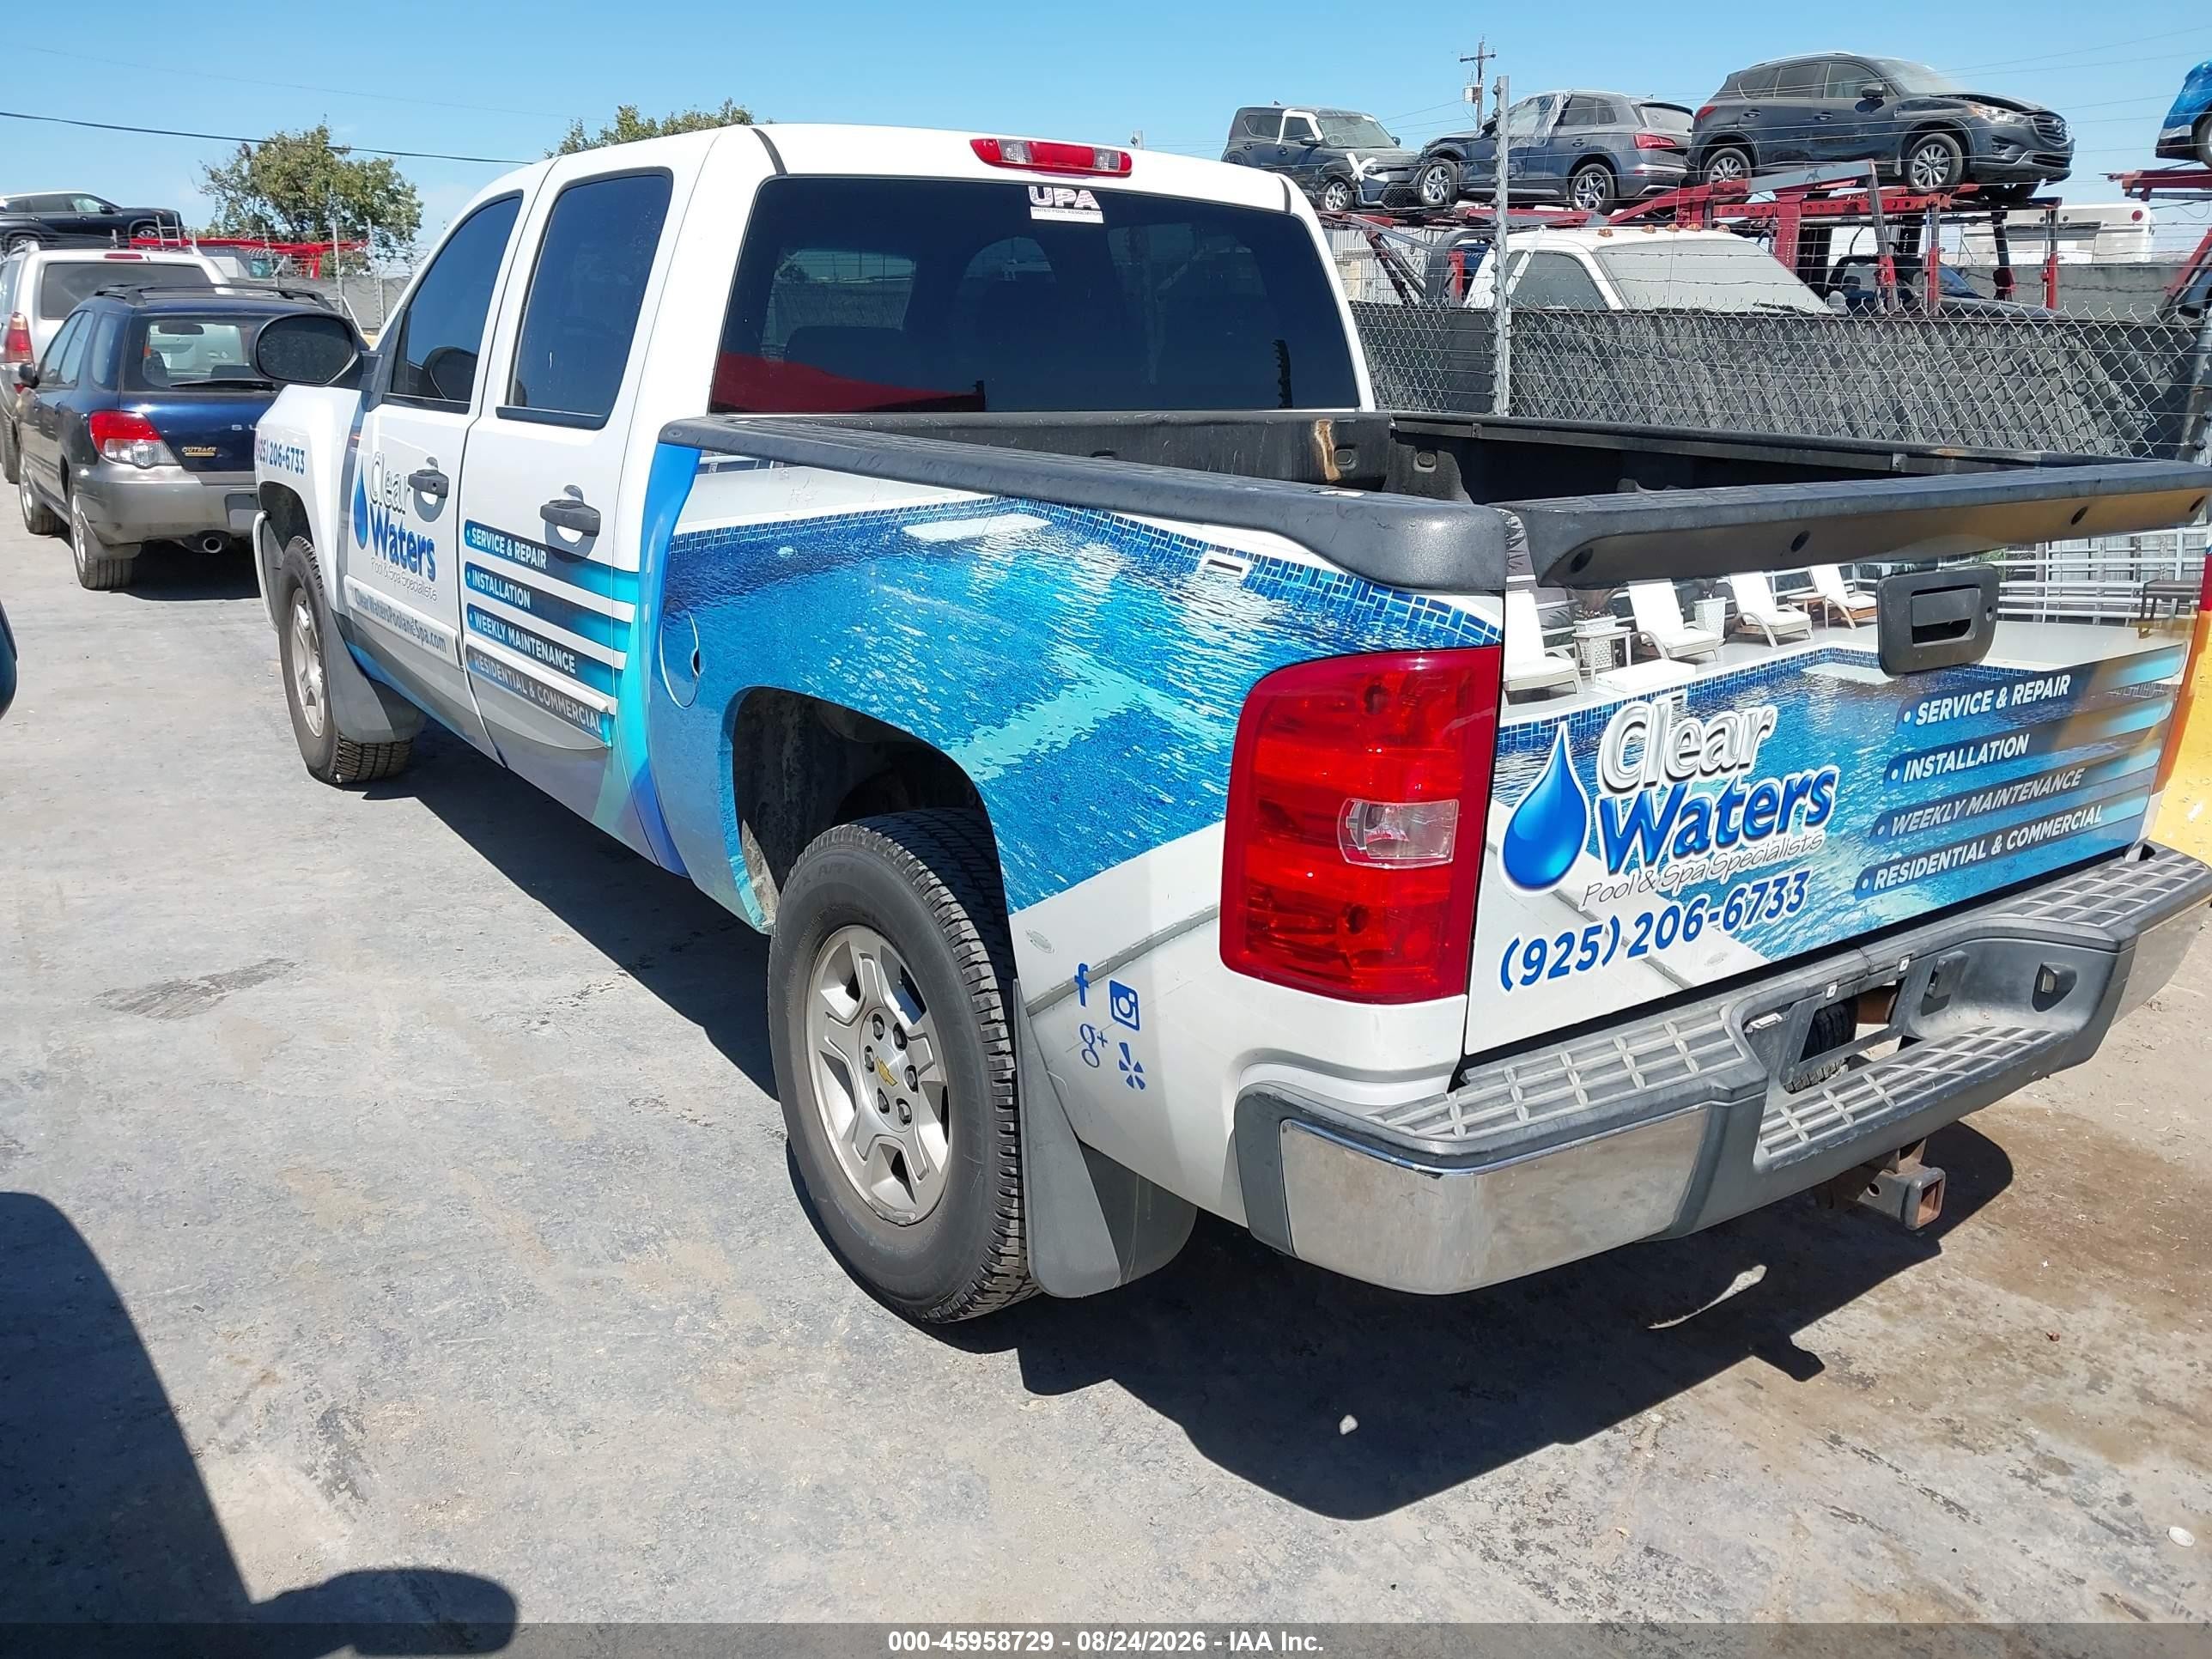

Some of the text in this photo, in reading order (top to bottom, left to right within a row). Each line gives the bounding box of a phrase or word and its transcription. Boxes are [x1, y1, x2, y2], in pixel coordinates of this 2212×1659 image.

[1028, 185, 1101, 210] UPA
[269, 441, 305, 475] 206-6733
[369, 451, 410, 515] Clear
[370, 503, 436, 582] Waters
[471, 527, 547, 569] SERVICE & REPAIR
[371, 557, 383, 575] Pool
[388, 565, 401, 588] Spa
[401, 571, 438, 602] Specialists
[472, 569, 531, 609] INSTALLATION
[474, 611, 576, 674] WEEKLY MAINTENANCE
[474, 652, 602, 732] RESIDENTIAL & COMMERCIAL
[1916, 674, 2071, 726] SERVICE & REPAIR
[1602, 702, 1774, 793] Clear
[1903, 733, 2030, 783] INSTALLATION
[1599, 769, 1839, 876] Waters
[1891, 768, 2086, 836] WEEKLY MAINTENANCE
[1582, 833, 1824, 907] Pool & Spa Specialists
[1873, 805, 2102, 890] RESIDENTIAL & COMMERCIAL
[1499, 870, 1812, 992] (925) 206-6733
